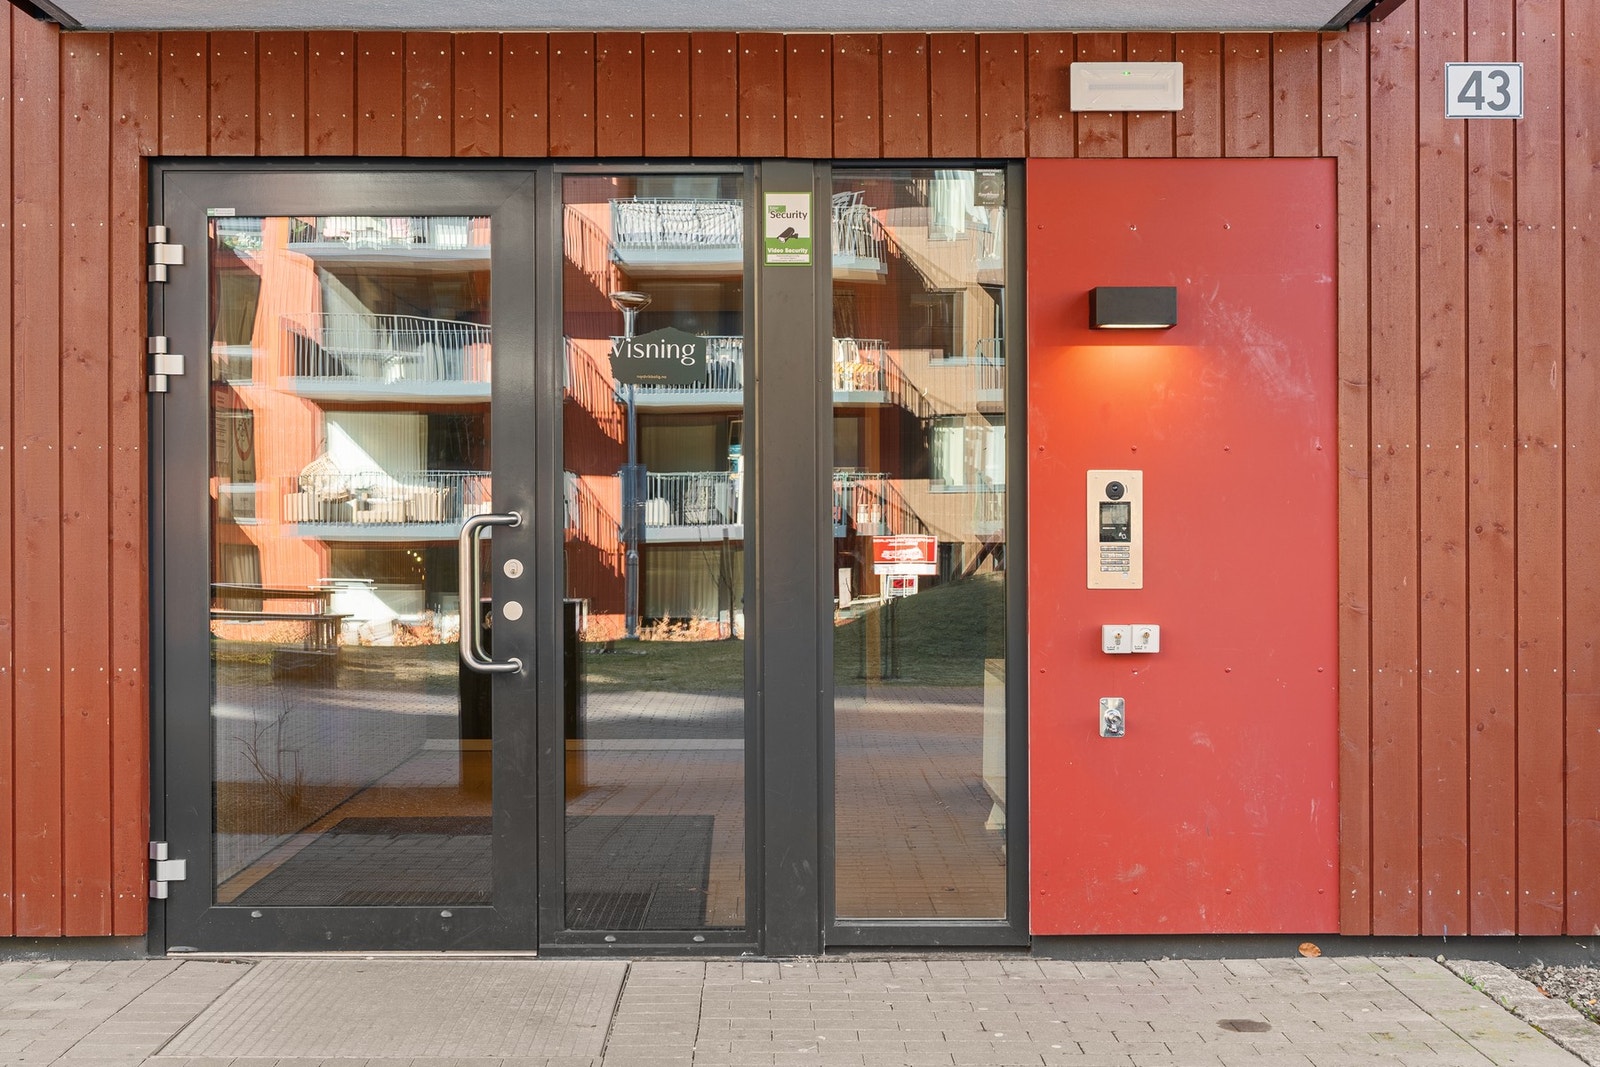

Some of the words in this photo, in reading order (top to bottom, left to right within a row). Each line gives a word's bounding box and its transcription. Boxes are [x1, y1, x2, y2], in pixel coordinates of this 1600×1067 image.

[1457, 69, 1511, 112] 43
[770, 210, 808, 220] Security
[612, 338, 696, 366] Visning
